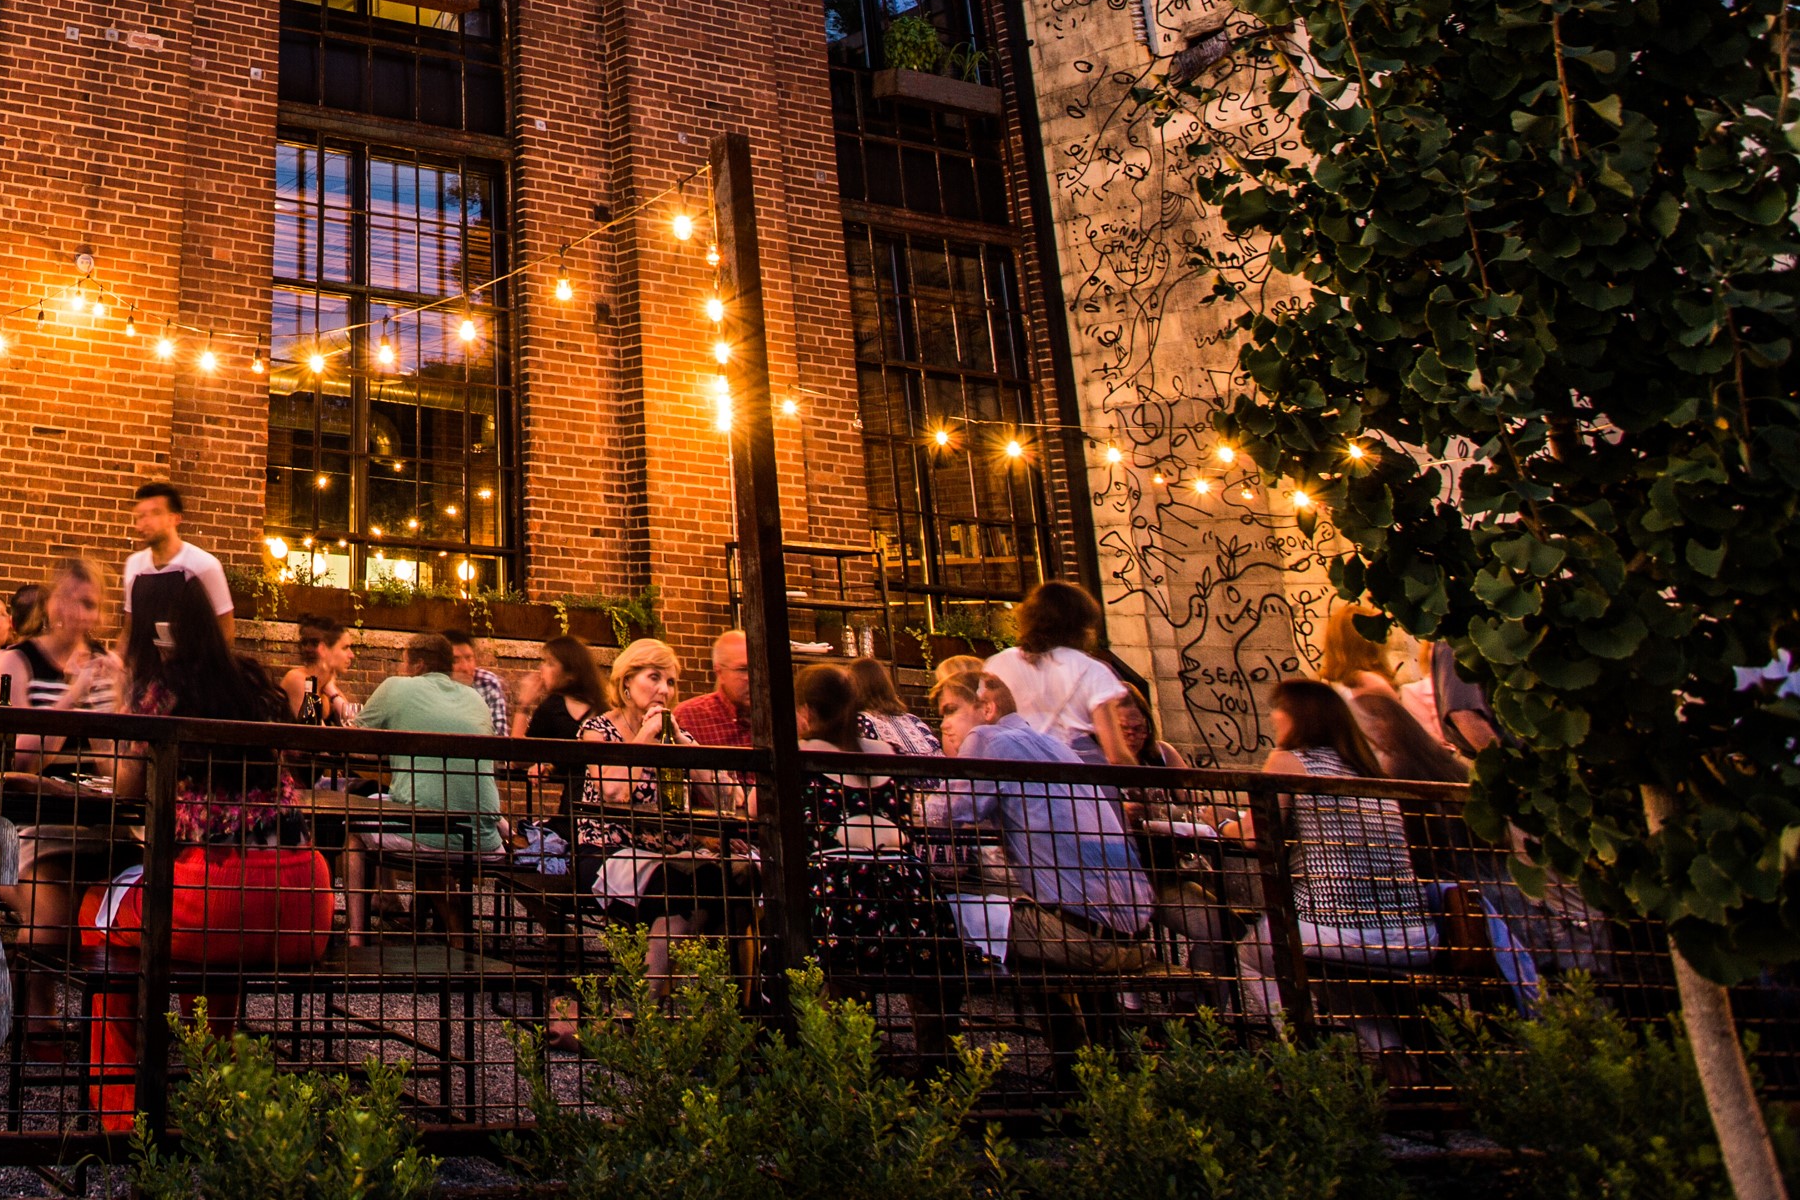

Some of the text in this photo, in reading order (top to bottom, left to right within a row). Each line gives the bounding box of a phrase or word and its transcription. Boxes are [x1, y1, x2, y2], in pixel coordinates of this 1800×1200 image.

[1166, 121, 1198, 157] WHO
[1202, 666, 1243, 690] SEA
[1211, 688, 1248, 714] YOU
